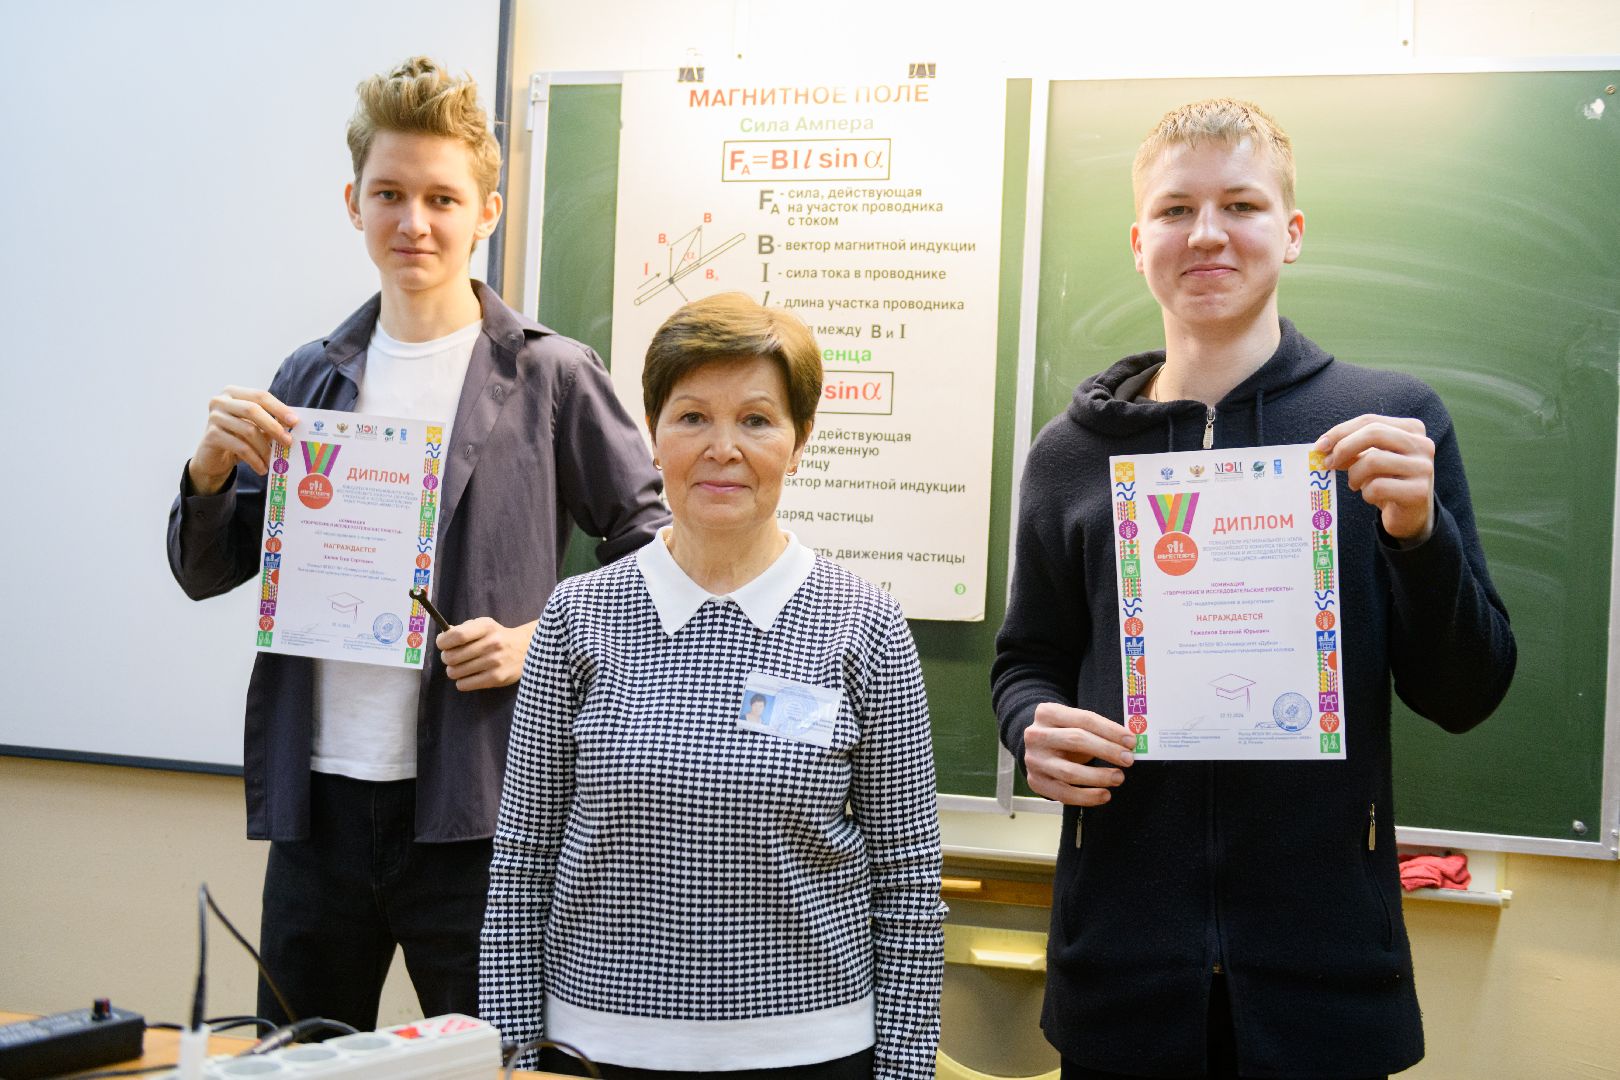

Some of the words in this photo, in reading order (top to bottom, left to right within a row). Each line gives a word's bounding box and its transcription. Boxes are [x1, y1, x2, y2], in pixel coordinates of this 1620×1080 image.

[689, 87, 847, 108] МАГНИТНОЕ
[855, 84, 929, 103] ПОЛЕ
[740, 117, 790, 133] Сила
[795, 116, 874, 134] Ампера
[819, 148, 858, 169] sin
[788, 188, 824, 200] сила,
[828, 187, 922, 200] действующая
[788, 203, 802, 212] на
[807, 202, 858, 214] участок
[862, 201, 944, 214] проводника
[788, 216, 795, 226] с
[799, 216, 839, 226] током
[785, 241, 831, 252] вектор
[834, 239, 906, 252] магнитной
[909, 242, 977, 254] индукции
[786, 269, 818, 279] сила
[822, 269, 850, 279] тока
[854, 269, 861, 279] в
[864, 268, 947, 281] проводнике
[784, 298, 824, 309] длина
[827, 299, 879, 310] участка
[882, 299, 965, 311] проводника
[817, 326, 862, 338] между
[886, 330, 894, 339] и
[823, 348, 873, 364] енца
[824, 381, 859, 400] sin
[817, 428, 912, 443] действующая
[803, 443, 880, 457] аряженную
[800, 459, 830, 471] тицу
[1215, 461, 1242, 473] МЭИ
[346, 467, 410, 485] ДИПЛОМ
[784, 477, 821, 490] ектор
[824, 478, 897, 491] магнитной
[900, 480, 966, 493] индукции
[776, 509, 814, 522] заряд
[817, 512, 874, 524] частицы
[1212, 513, 1294, 535] ДИПЛОМ
[323, 542, 377, 553] НАГРАЖДАЕТСЯ
[836, 548, 903, 561] движения
[907, 551, 965, 564] частицы
[1196, 613, 1263, 622] НАГРАЖДАЕТСЯ
